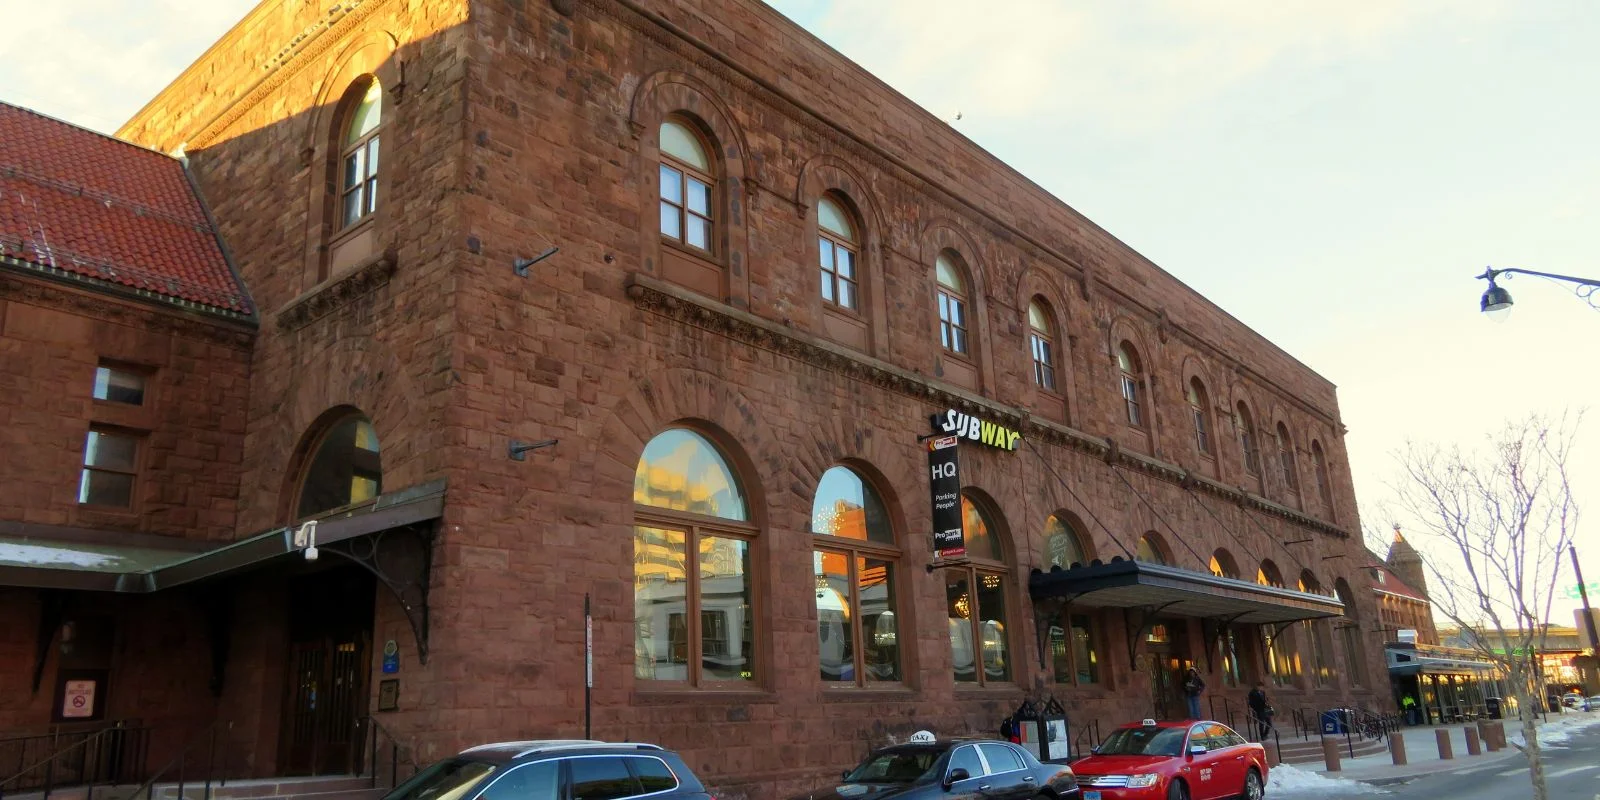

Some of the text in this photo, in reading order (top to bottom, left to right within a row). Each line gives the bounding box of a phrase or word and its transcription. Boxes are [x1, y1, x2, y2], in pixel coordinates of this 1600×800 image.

[942, 408, 1021, 451] SUBWAY
[931, 461, 956, 480] HQ
[935, 492, 957, 501] Parking
[935, 528, 961, 539] Propark
